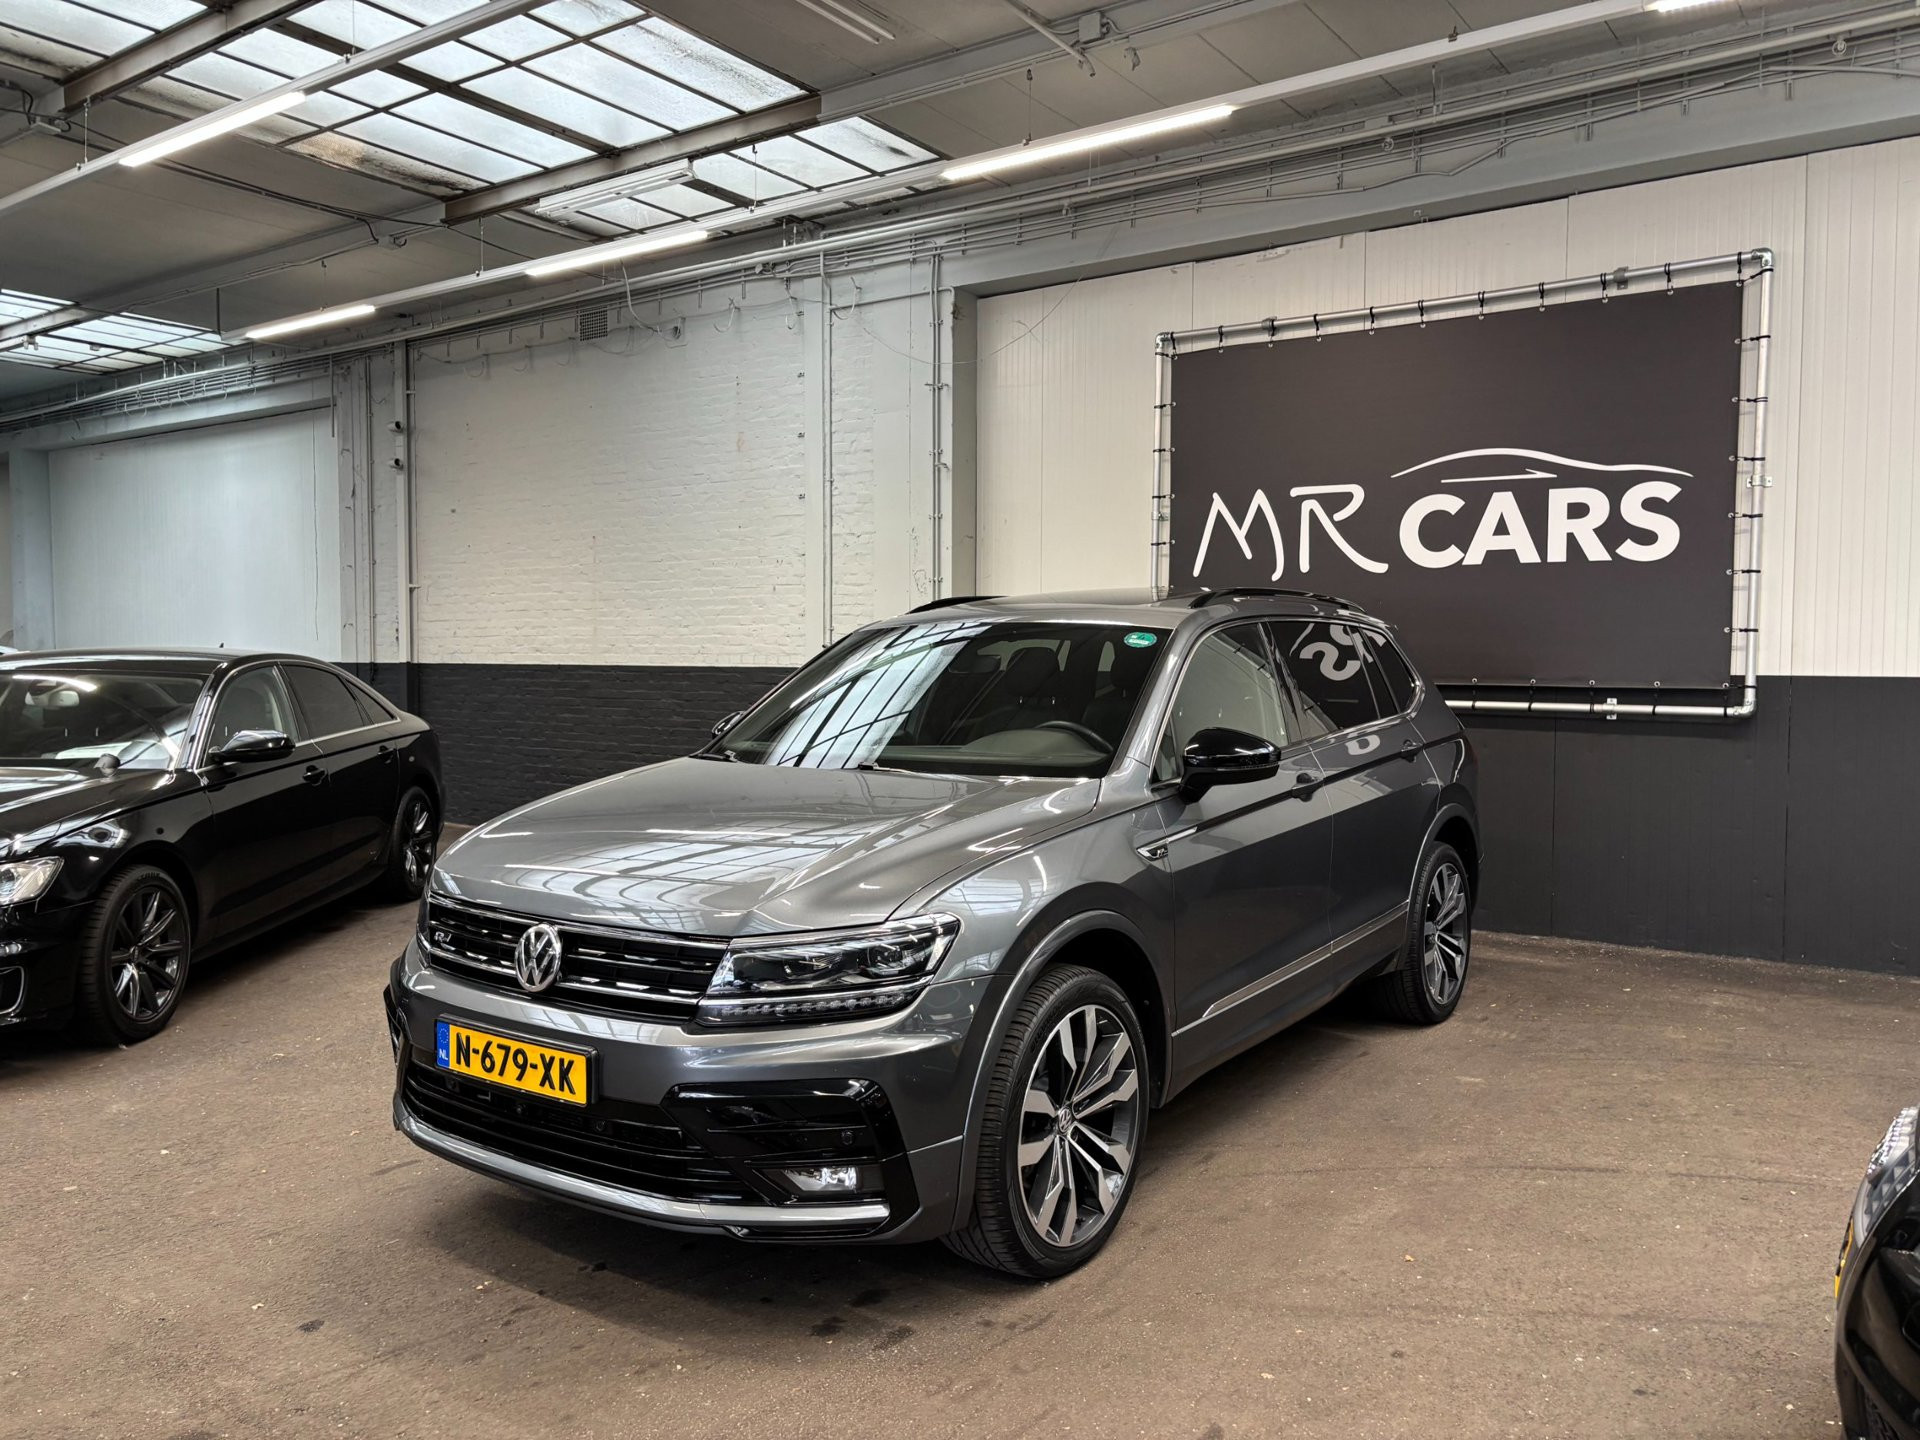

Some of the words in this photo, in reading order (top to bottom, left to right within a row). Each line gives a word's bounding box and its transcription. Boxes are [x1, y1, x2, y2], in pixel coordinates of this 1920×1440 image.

[1193, 483, 1389, 581] MR
[1399, 481, 1682, 568] CARS
[439, 1048, 449, 1061] NL
[456, 1032, 576, 1095] N-679-XK
